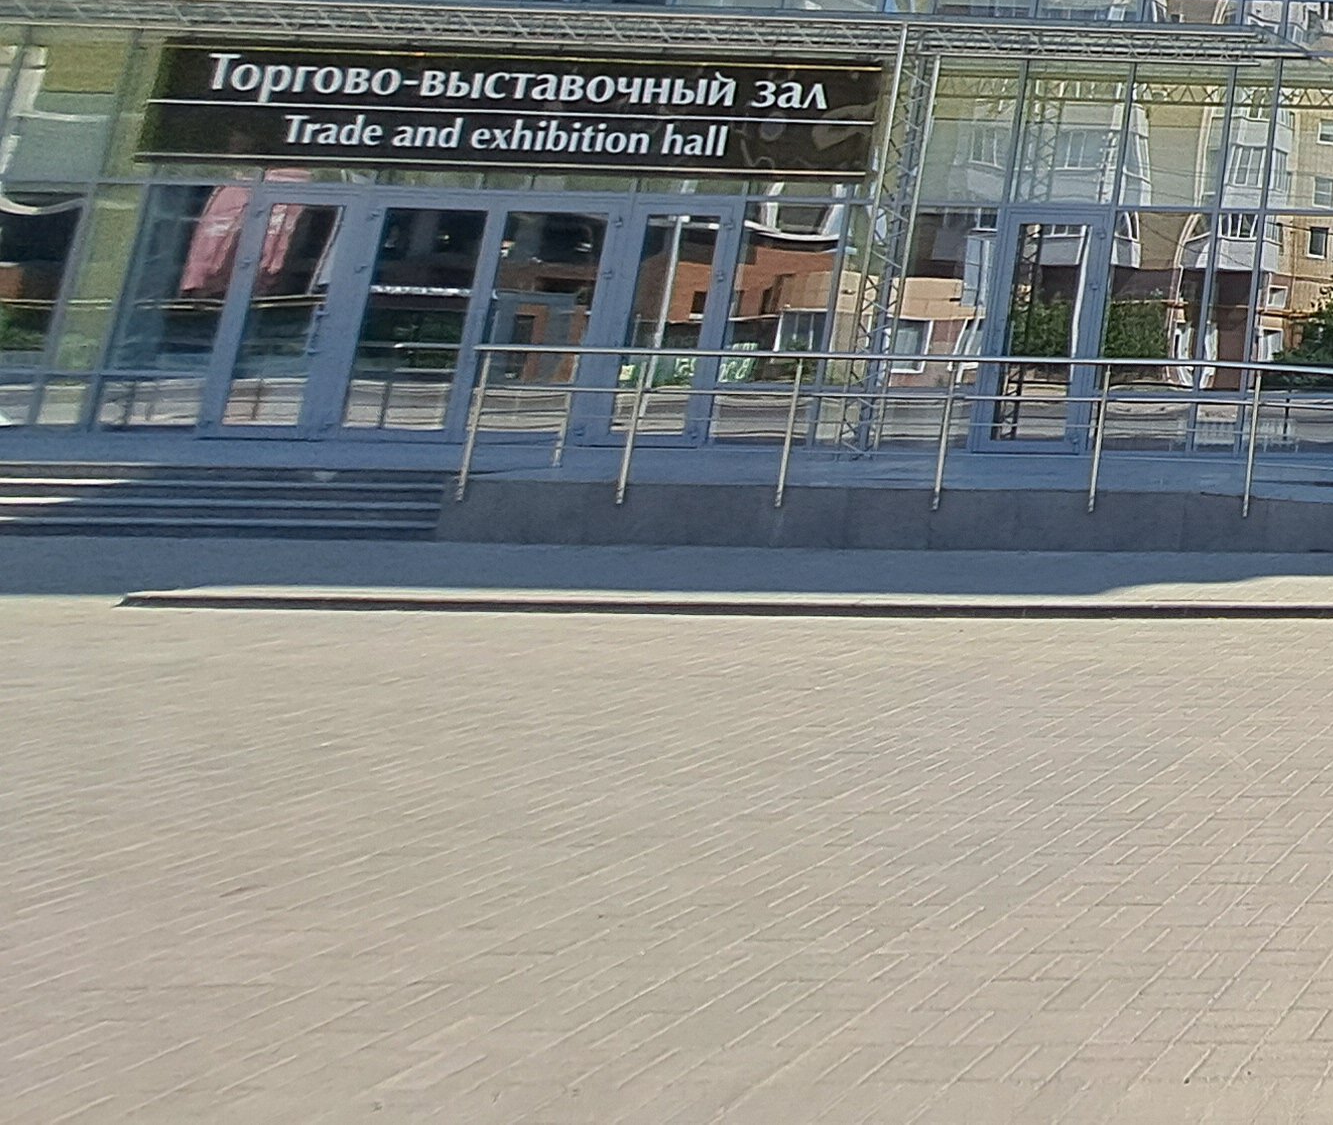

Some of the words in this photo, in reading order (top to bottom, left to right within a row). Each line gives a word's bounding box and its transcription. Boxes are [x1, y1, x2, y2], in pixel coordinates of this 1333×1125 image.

[209, 53, 737, 107] Торгово-выставочный
[750, 80, 828, 110] зал
[285, 114, 383, 145] Trade
[392, 117, 464, 148] and
[471, 119, 650, 155] exhibition
[660, 124, 729, 157] hall
